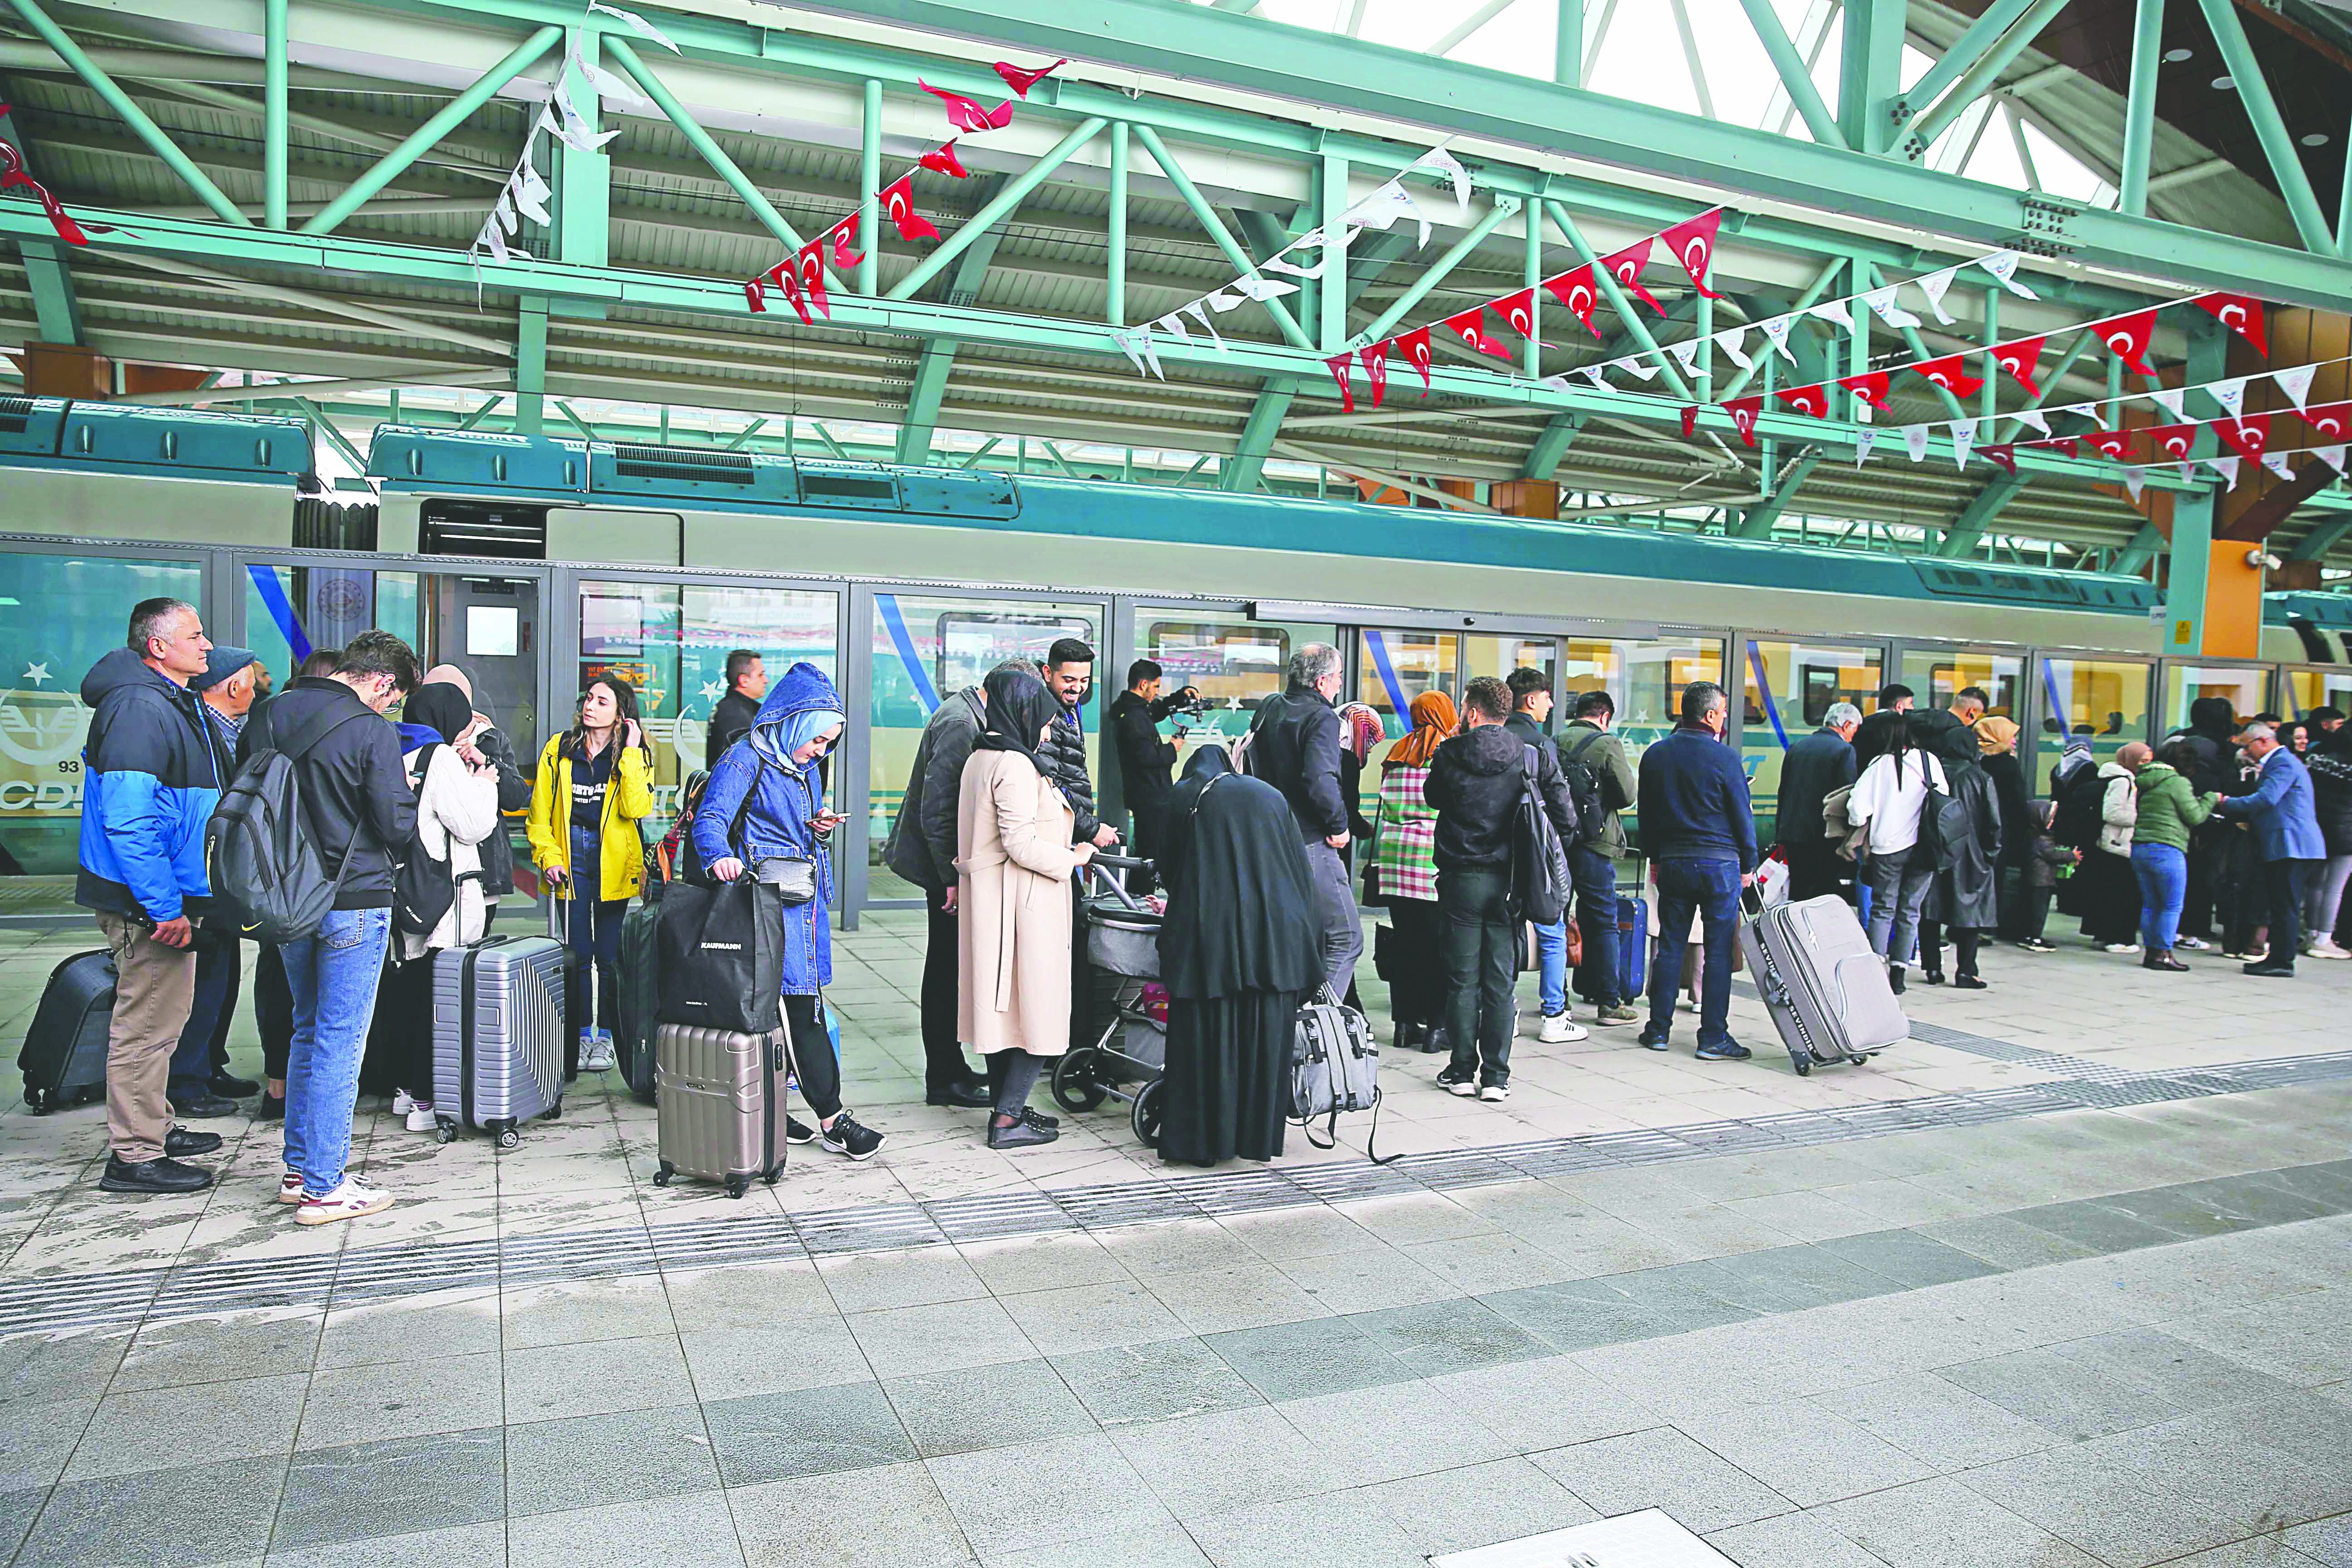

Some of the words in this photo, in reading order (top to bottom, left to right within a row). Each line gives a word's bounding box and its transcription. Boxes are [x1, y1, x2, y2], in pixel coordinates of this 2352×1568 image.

[59, 761, 79, 773] 93
[0, 780, 84, 810] CD
[701, 942, 741, 950] KAUFMANN
